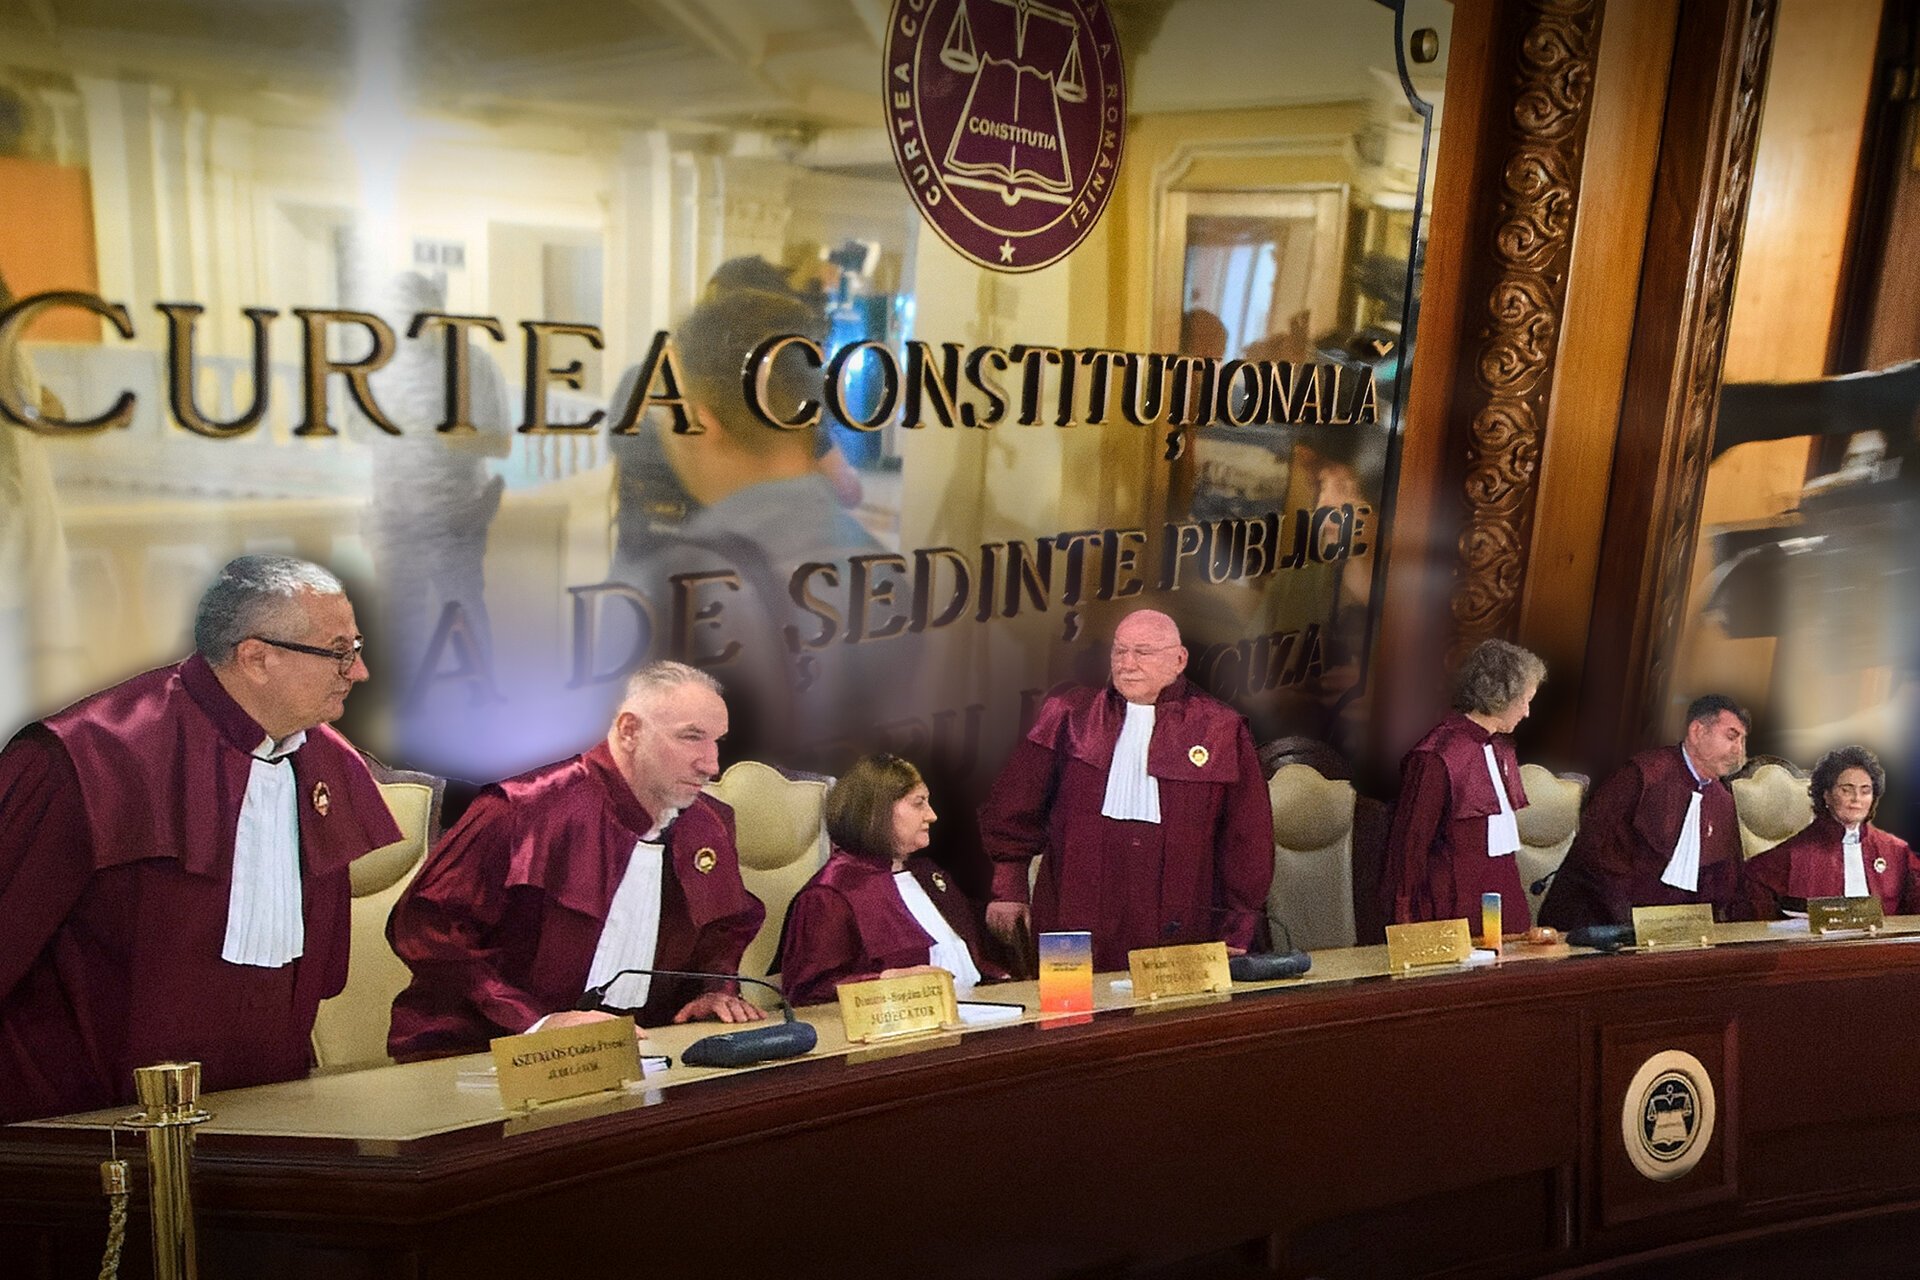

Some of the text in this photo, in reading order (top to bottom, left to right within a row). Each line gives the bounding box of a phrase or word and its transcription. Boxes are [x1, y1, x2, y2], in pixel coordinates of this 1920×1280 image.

[894, 63, 942, 207] CURTEA
[968, 116, 1057, 152] CONSTITUTIA
[0, 290, 706, 438] CURTEA
[566, 568, 745, 690] DE
[1156, 502, 1373, 593] PUBLICE
